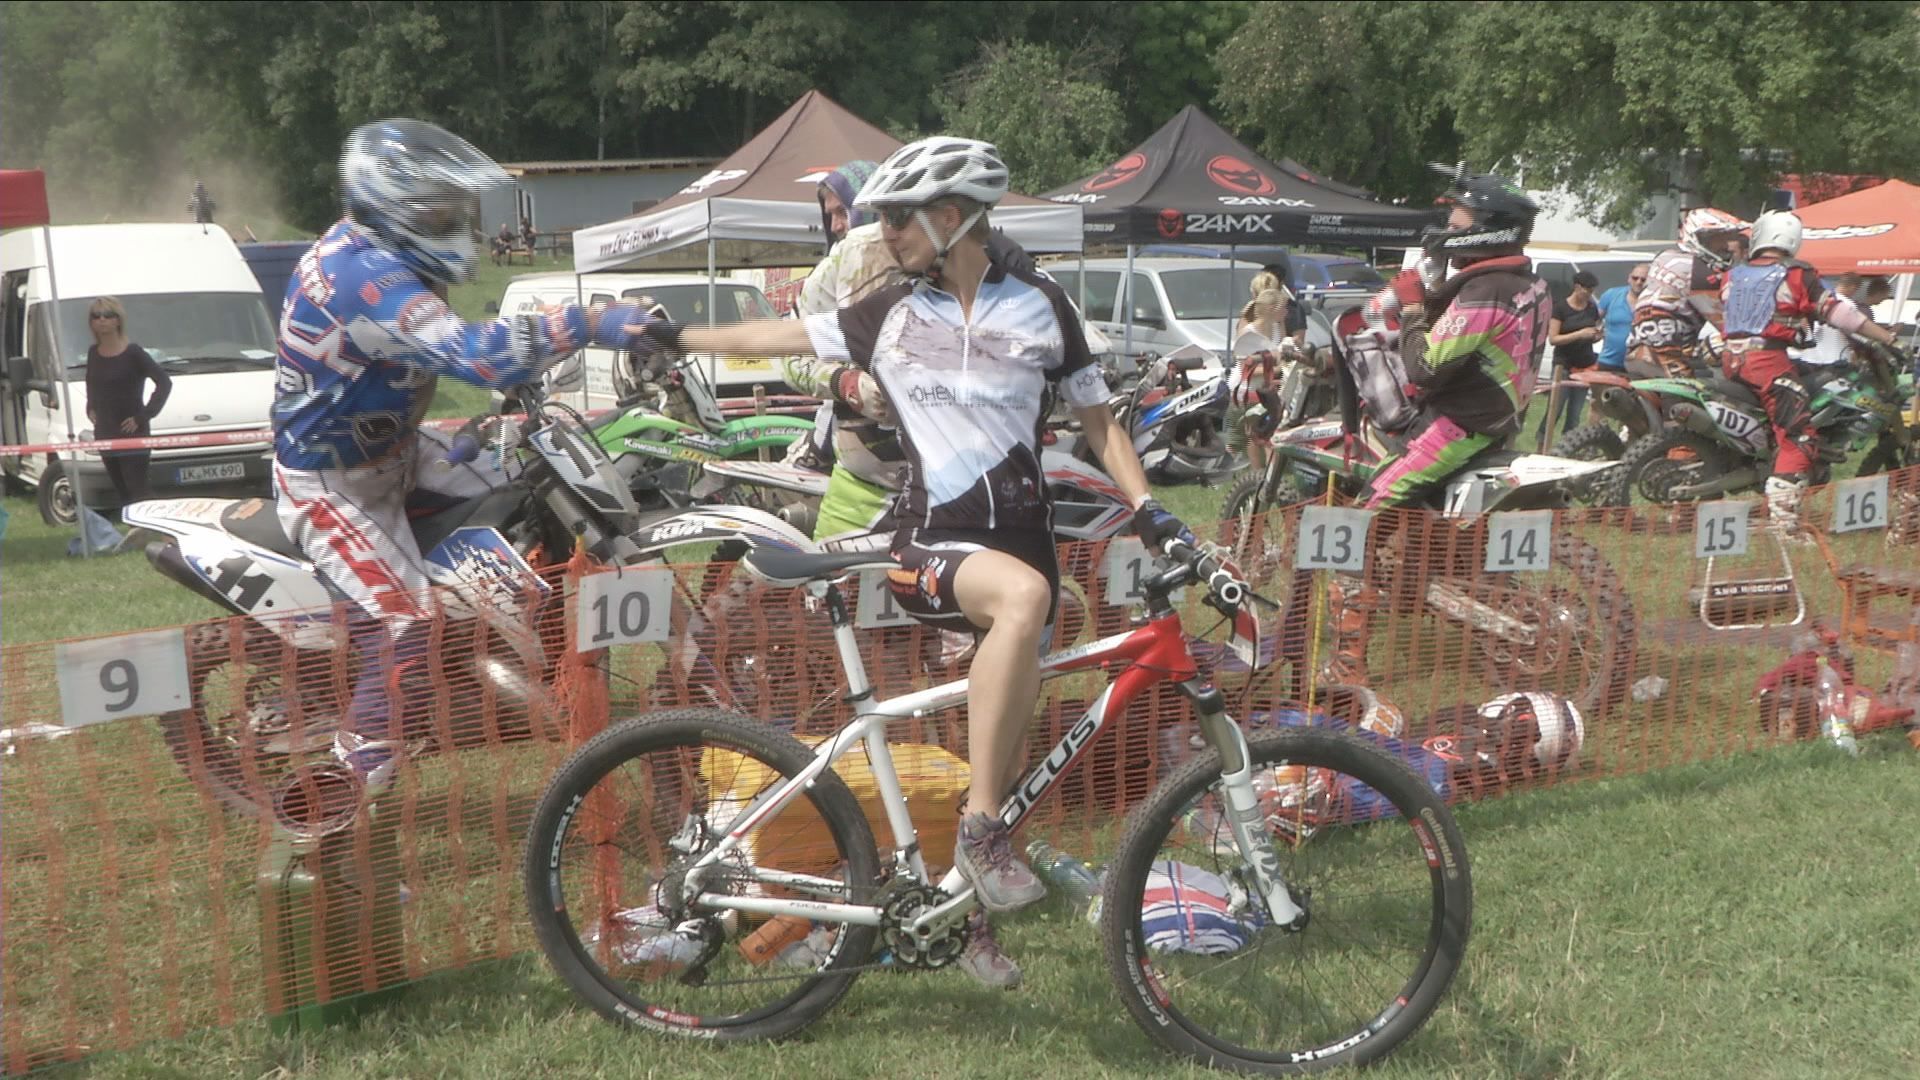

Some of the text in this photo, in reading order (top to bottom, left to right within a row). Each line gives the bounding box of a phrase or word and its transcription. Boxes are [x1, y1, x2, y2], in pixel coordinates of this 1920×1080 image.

[1218, 196, 1315, 207] 24MX
[1185, 214, 1273, 233] 24MX
[1715, 407, 1750, 438] 107
[624, 438, 672, 455] Kawasaki
[221, 464, 242, 479] 690
[1844, 491, 1877, 527] 16
[651, 520, 705, 542] KTM
[1310, 524, 1353, 565] 13
[1498, 529, 1538, 565] 14
[1704, 517, 1735, 552] 15
[1125, 557, 1145, 599] 1
[592, 591, 650, 643] 10
[876, 579, 900, 621] 1
[99, 659, 139, 713] 9
[1002, 714, 1096, 831] OCUS
[1420, 807, 1457, 868] Continental
[1136, 983, 1170, 1026] RACE
